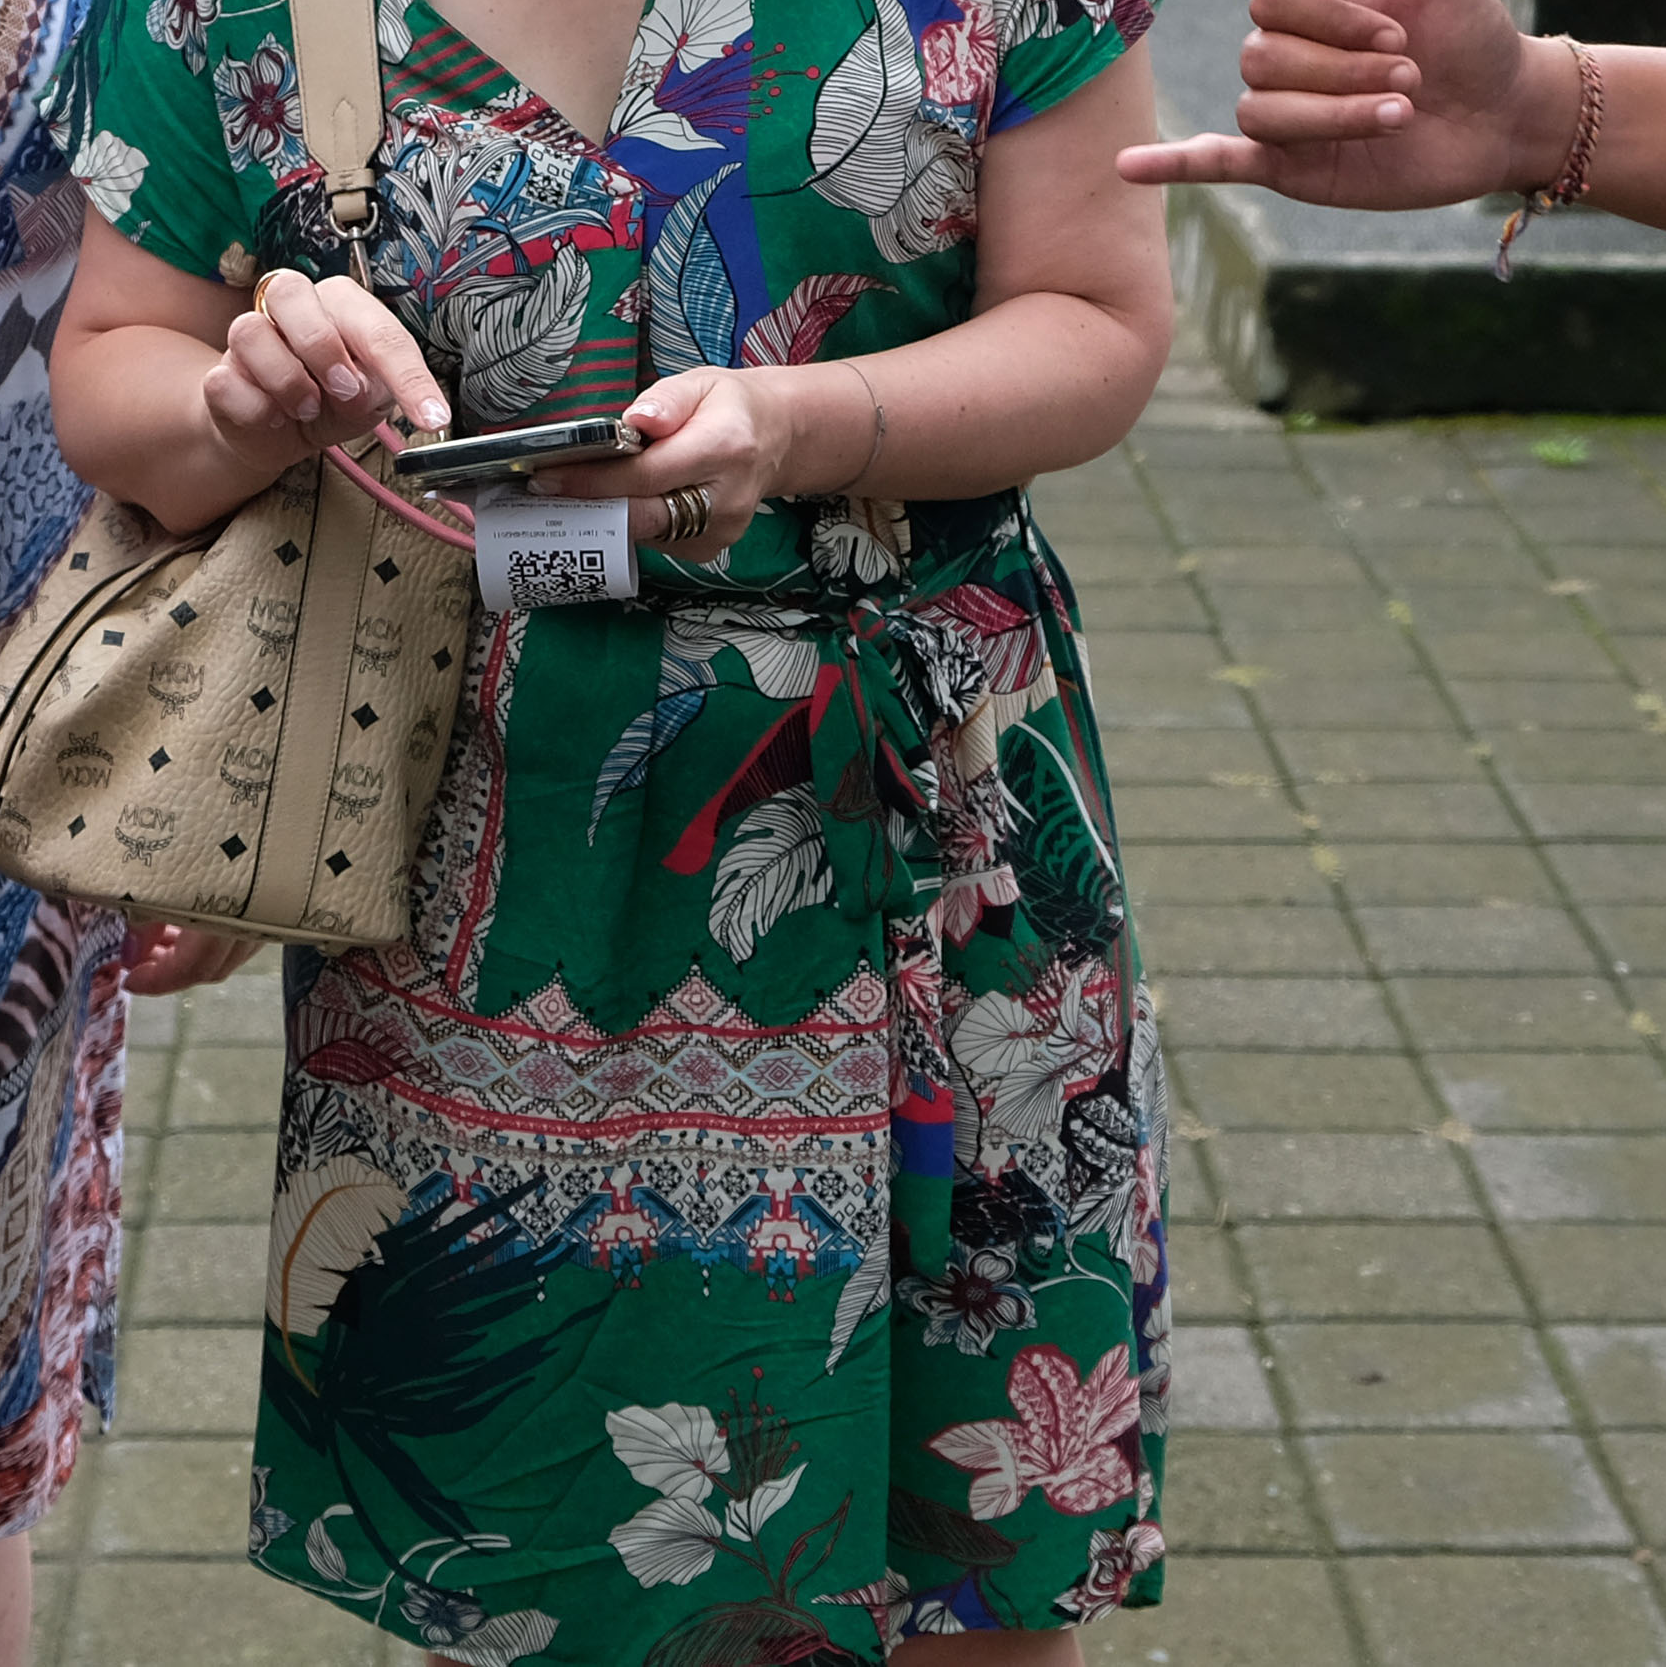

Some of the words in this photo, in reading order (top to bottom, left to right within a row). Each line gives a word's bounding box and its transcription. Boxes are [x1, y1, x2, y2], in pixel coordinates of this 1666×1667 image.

[149, 661, 206, 686] MCM
[58, 765, 113, 790] MCM
[333, 762, 384, 790] MCM
[118, 803, 177, 832] MCM
